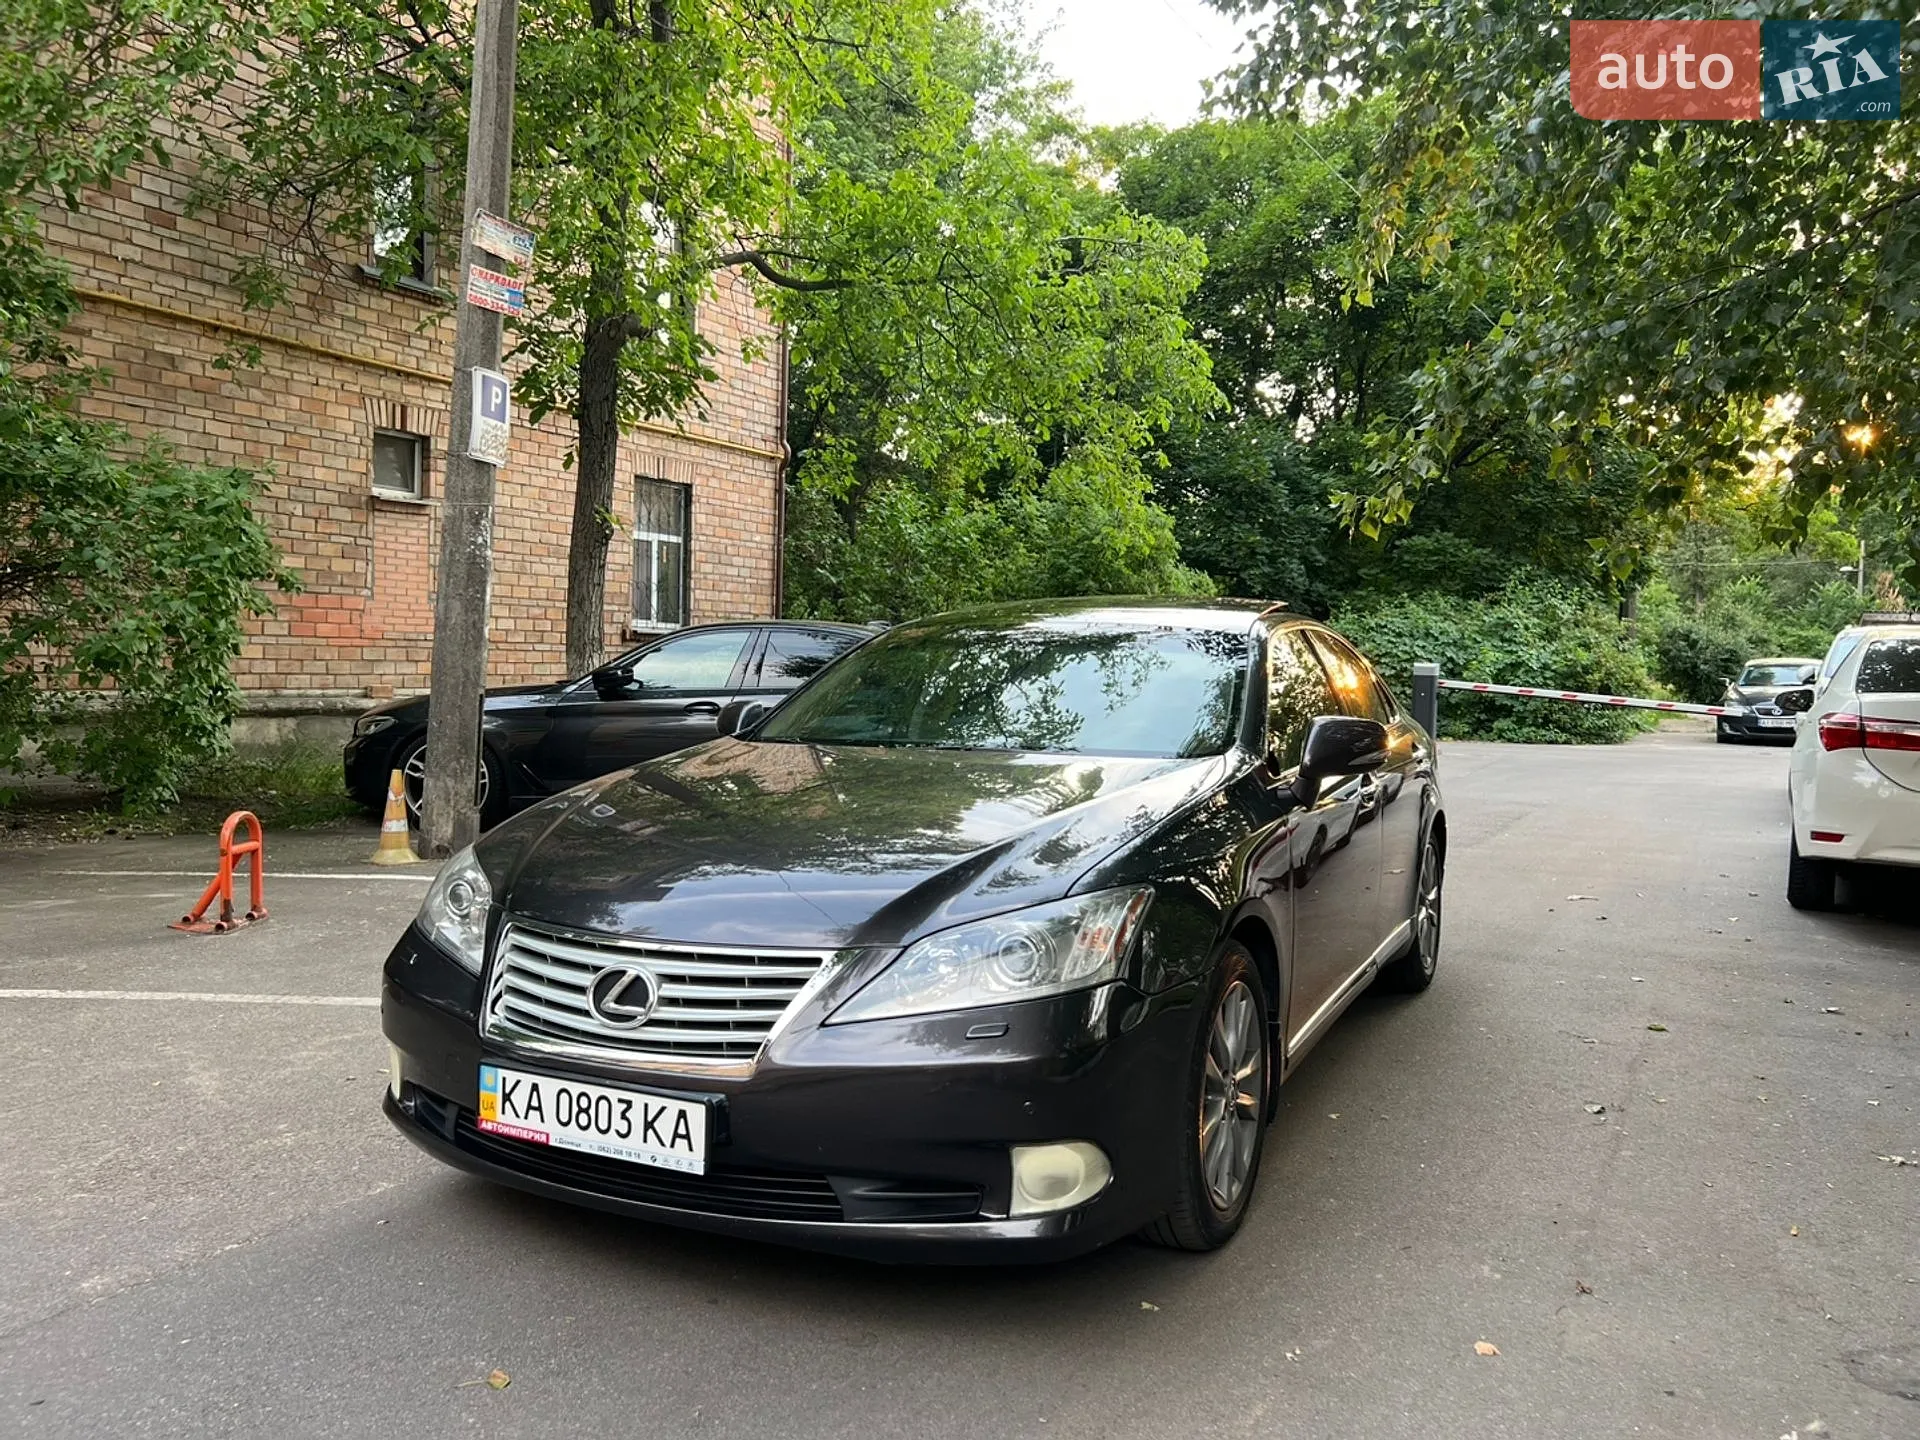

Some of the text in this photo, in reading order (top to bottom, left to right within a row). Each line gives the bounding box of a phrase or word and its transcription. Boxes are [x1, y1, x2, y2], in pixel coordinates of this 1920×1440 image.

[491, 385, 502, 412] P
[482, 1100, 495, 1112] UA
[501, 1076, 694, 1152] KA 0803 KA
[481, 1121, 547, 1143] АВТОИМПЕРИЯ
